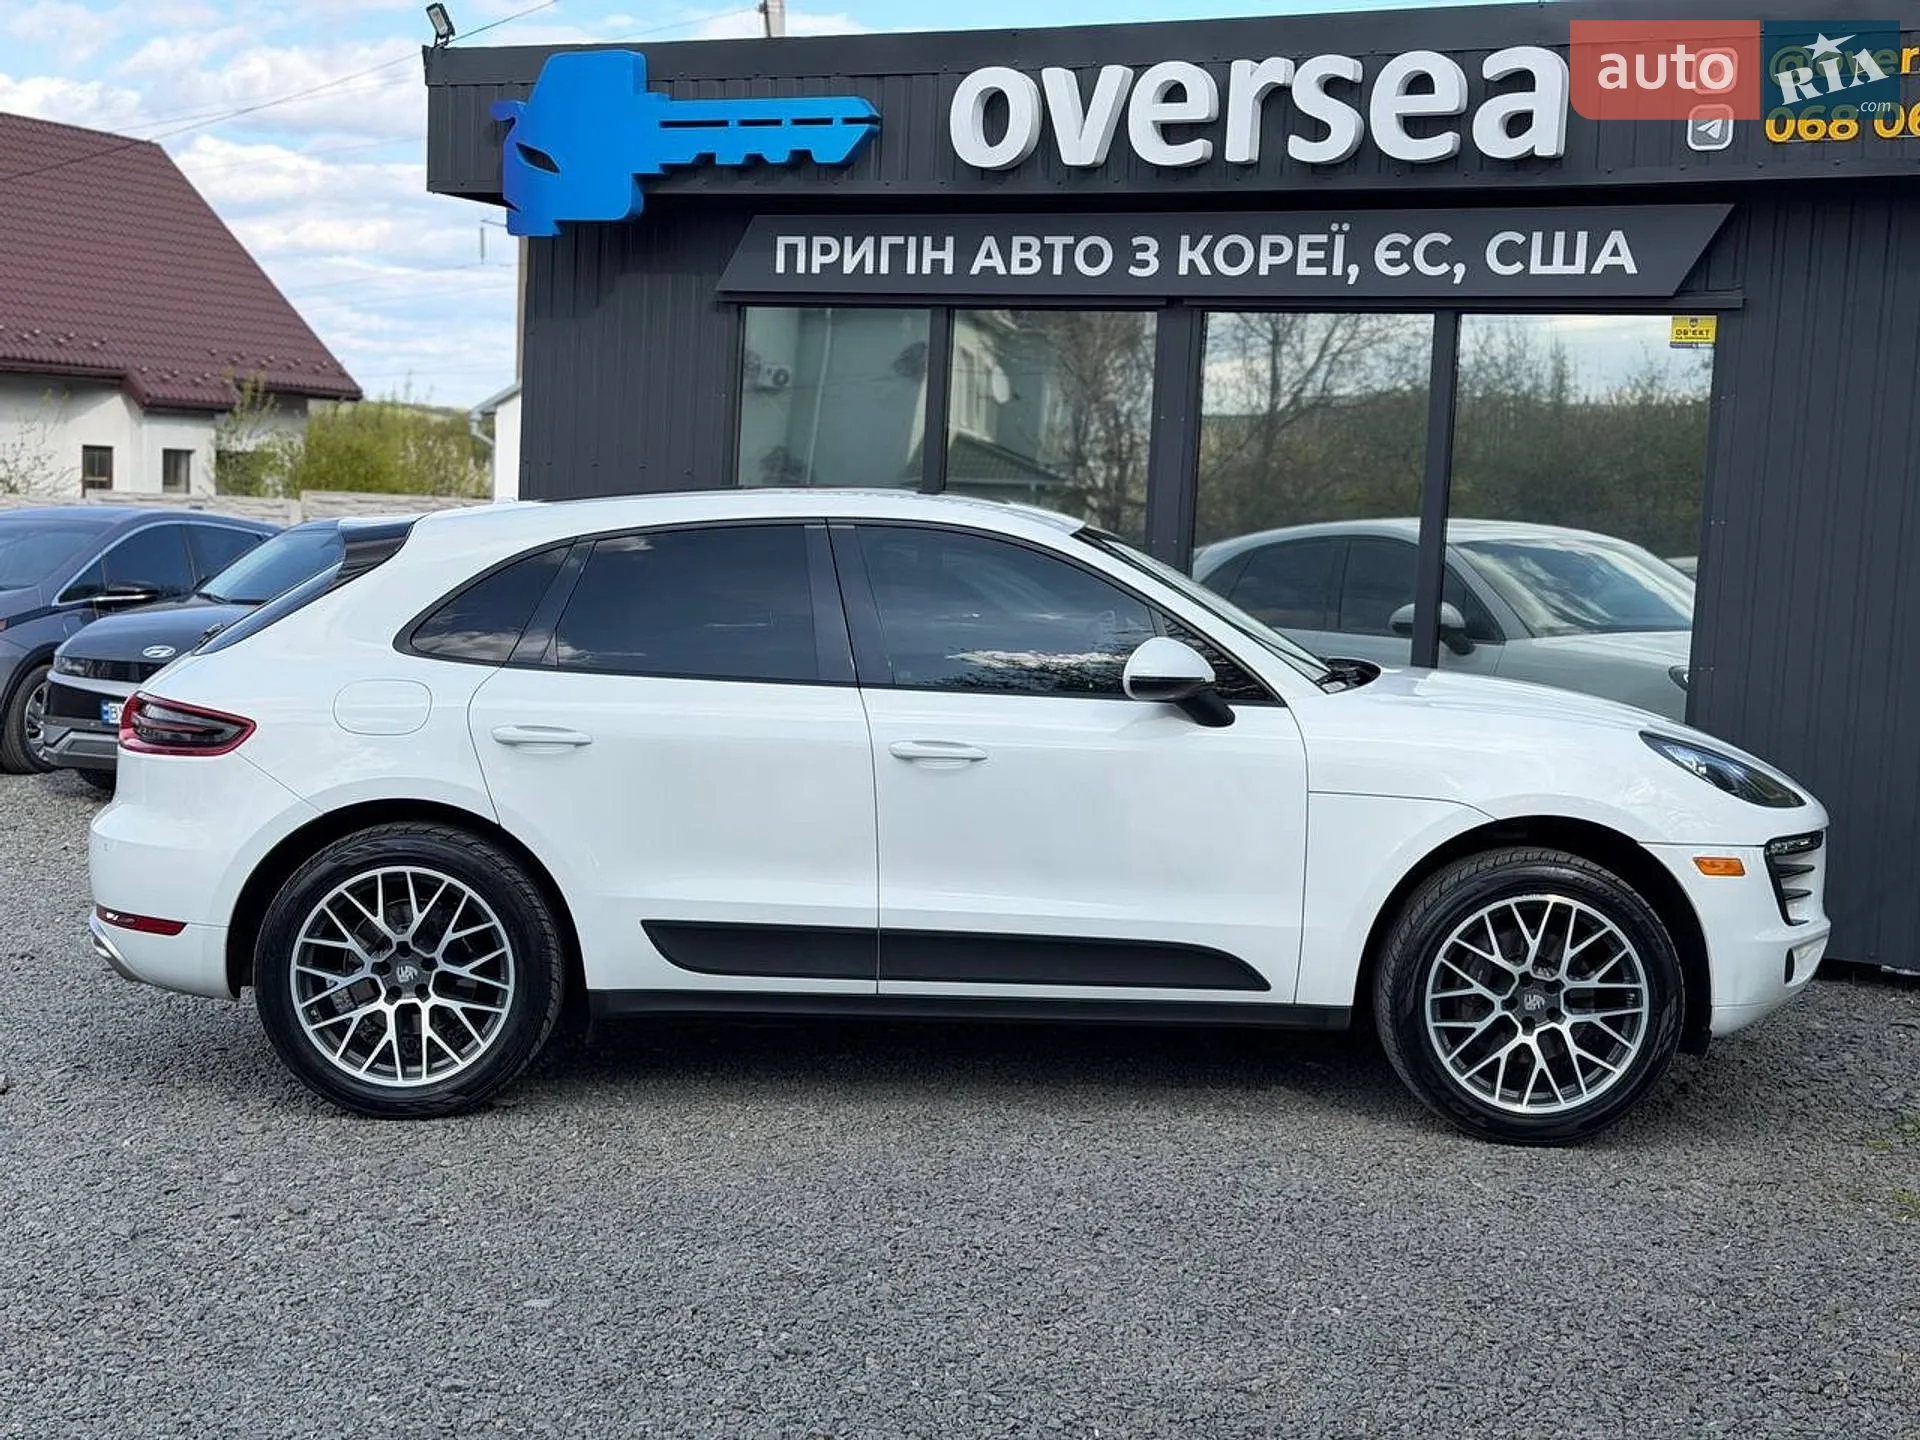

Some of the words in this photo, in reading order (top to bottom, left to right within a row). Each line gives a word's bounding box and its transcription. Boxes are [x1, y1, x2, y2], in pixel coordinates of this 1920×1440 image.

[949, 45, 1570, 170] oversea
[1764, 104, 1860, 142] 068
[775, 235, 954, 275] ПРИГІН
[970, 235, 1113, 276] АВТО
[1178, 223, 1359, 285] КОРЕЇ,
[1373, 231, 1466, 284] ЄС,
[1485, 230, 1638, 276] США
